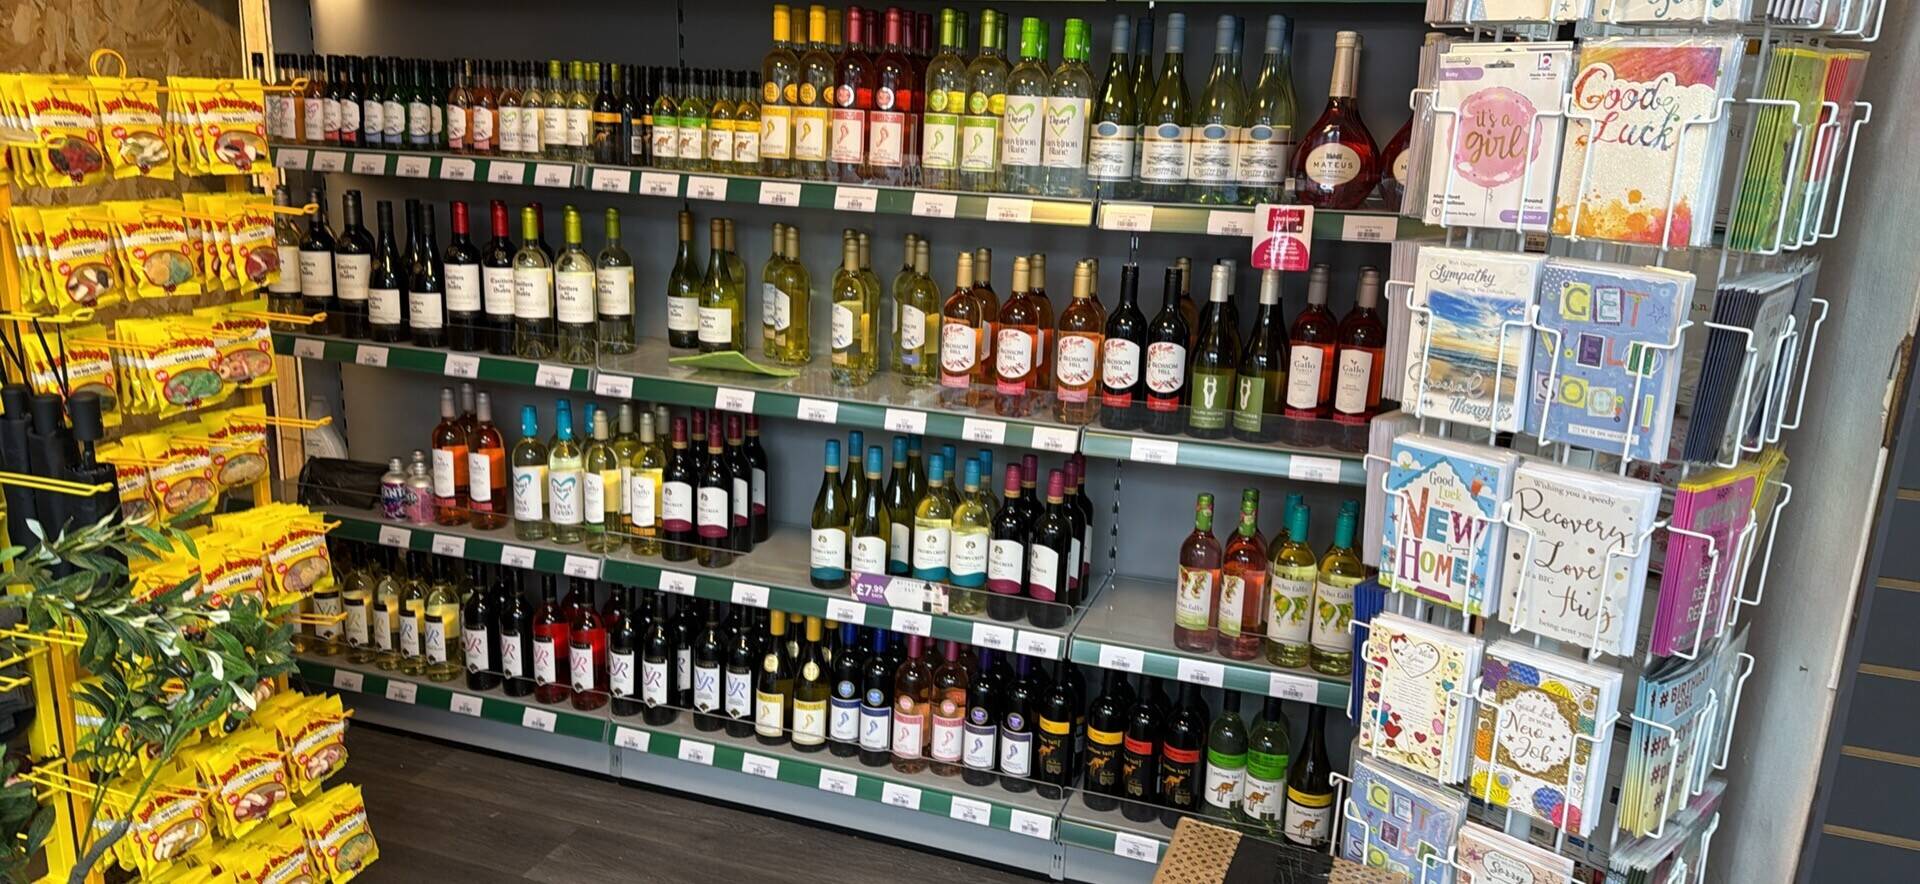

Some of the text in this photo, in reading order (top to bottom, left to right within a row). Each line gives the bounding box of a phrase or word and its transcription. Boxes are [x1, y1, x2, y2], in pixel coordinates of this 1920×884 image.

[1575, 67, 1681, 114] Good
[1476, 110, 1513, 129] it's a
[1586, 113, 1684, 151] Luck
[1464, 124, 1524, 165] girl
[1313, 161, 1354, 170] MATEUS
[1430, 263, 1497, 288] Sympathy
[1565, 286, 1650, 328] GET
[1294, 361, 1316, 370] Gallo
[1342, 365, 1365, 374] Gallo
[1449, 396, 1512, 423] Thougts
[1429, 471, 1455, 487] Good
[1438, 485, 1462, 502] Luck
[1534, 479, 1564, 499] Wishing
[1565, 488, 1580, 500] you
[1587, 493, 1616, 508] speedy
[1401, 487, 1488, 546] NEW
[1515, 487, 1633, 559] Recovery
[1397, 537, 1470, 588] HOME
[1534, 539, 1601, 581] Love
[856, 582, 885, 597] £7.99
[1546, 584, 1617, 634] Hug
[1538, 617, 1560, 632] being
[1560, 624, 1576, 635] sent
[1670, 666, 1710, 704] BIRTHDAY
[1514, 700, 1556, 721] Good Luck
[1674, 699, 1693, 717] GIRL
[1501, 709, 1544, 739] New
[1517, 734, 1551, 764] Job
[1490, 858, 1525, 884] Sorry
